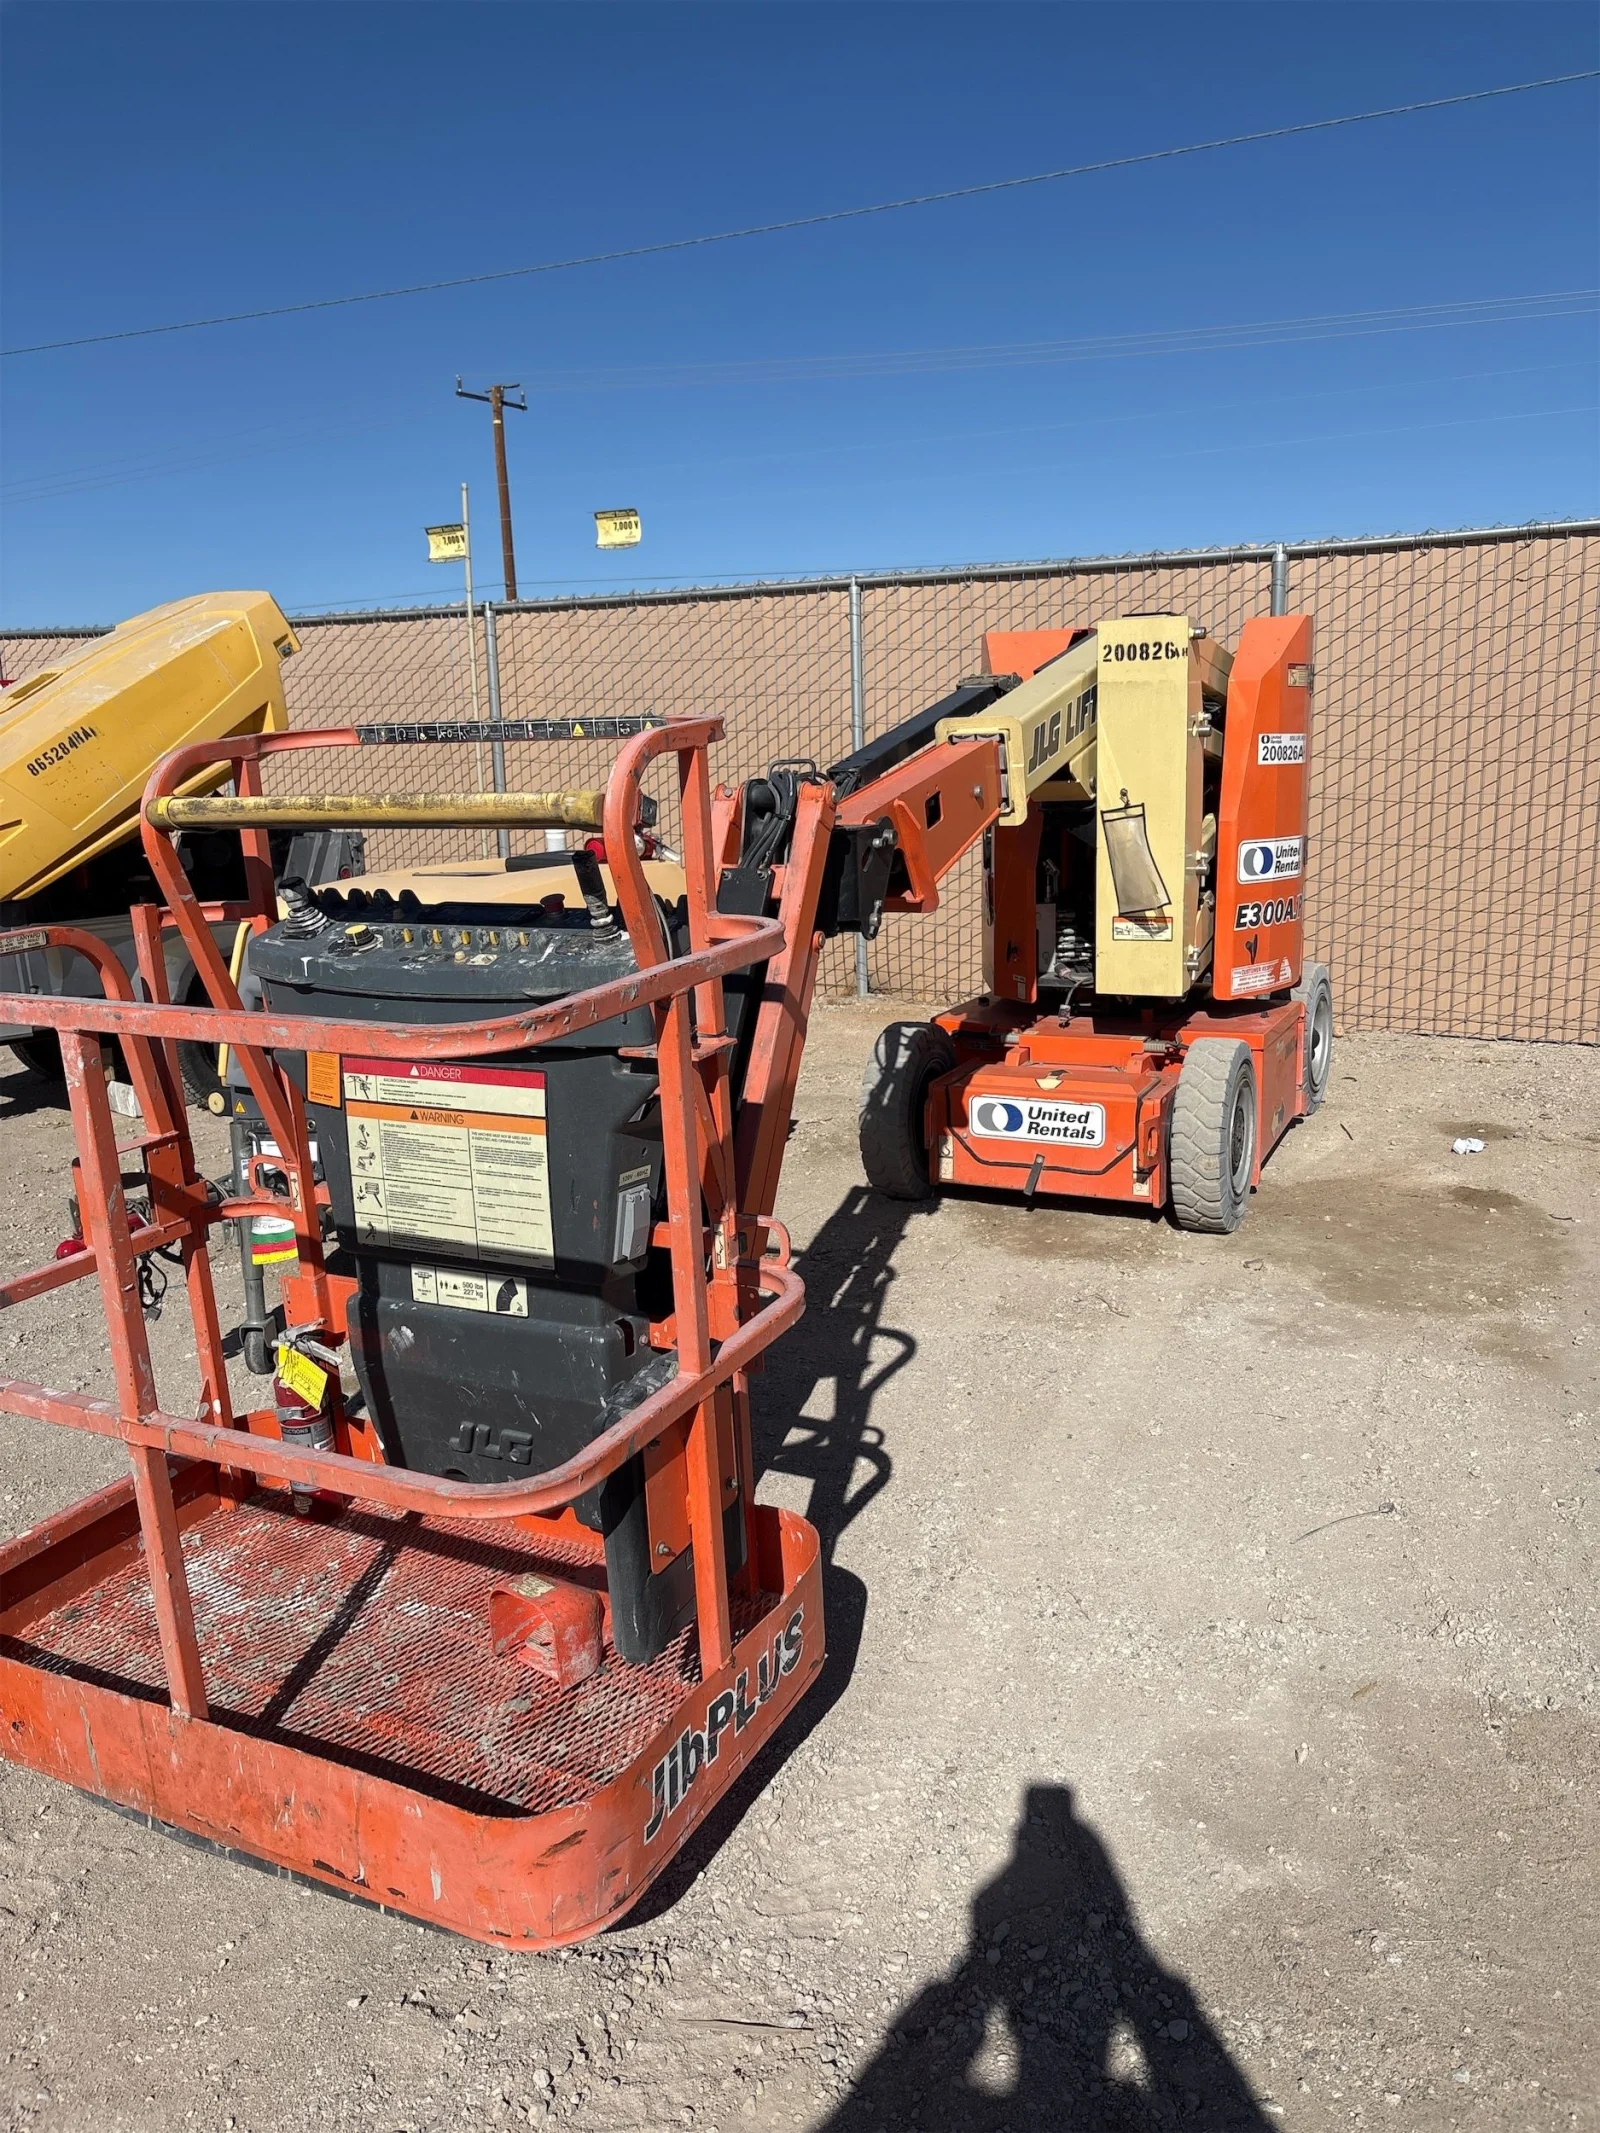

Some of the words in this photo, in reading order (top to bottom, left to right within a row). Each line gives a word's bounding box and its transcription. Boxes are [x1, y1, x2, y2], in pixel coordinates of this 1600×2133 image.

[612, 521, 632, 532] 7,000
[634, 520, 639, 529] V
[442, 535, 460, 546] 7,000
[1028, 709, 1062, 776] JLG
[1262, 745, 1304, 761] 200826A
[420, 1067, 461, 1080] DANGER
[420, 1112, 464, 1124] WARNING
[1028, 1106, 1090, 1124] United
[1027, 1122, 1096, 1140] Rentals
[475, 1290, 483, 1298] kg
[449, 1420, 533, 1466] JLG
[644, 1603, 805, 1846] JibPLUS
